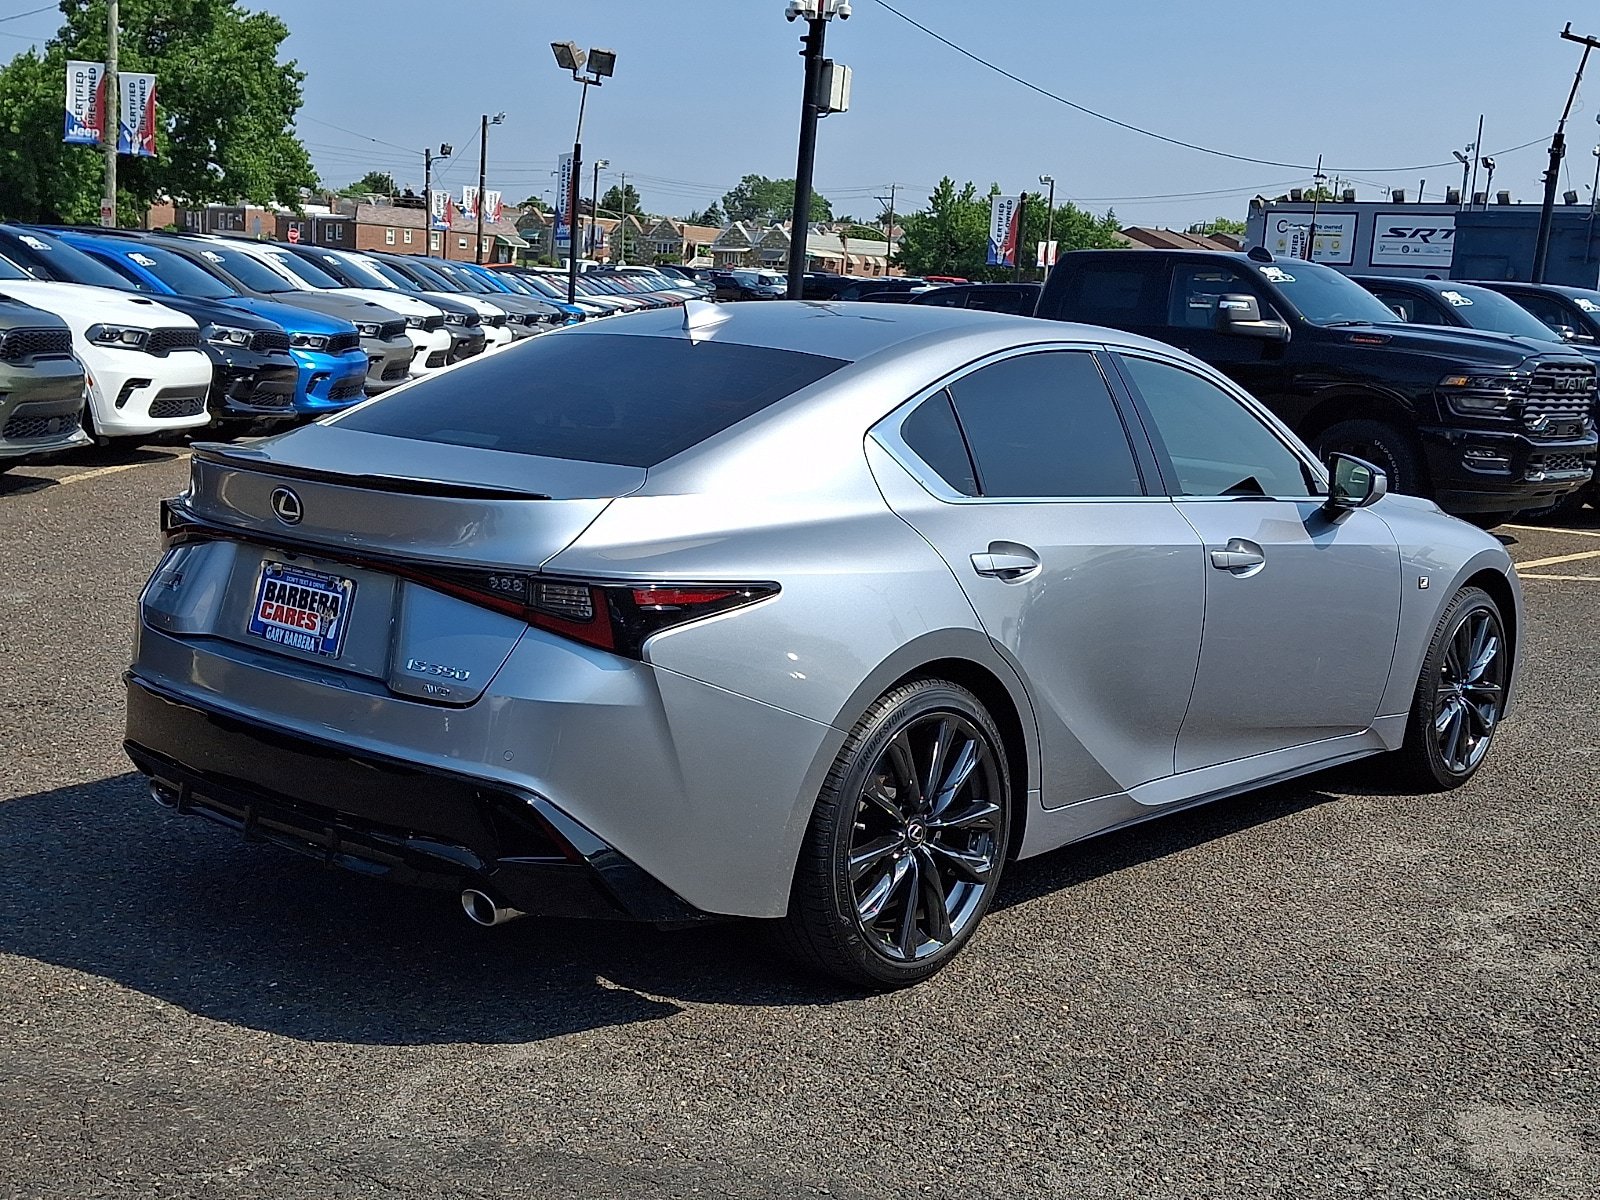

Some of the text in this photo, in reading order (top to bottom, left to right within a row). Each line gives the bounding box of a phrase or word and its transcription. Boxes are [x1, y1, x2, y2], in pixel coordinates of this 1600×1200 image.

[74, 71, 84, 122] CERTIFIED
[88, 67, 97, 127] PRE-OWNED
[128, 82, 136, 128] CERTIFIED
[68, 124, 100, 138] Jeep
[996, 203, 1005, 243] CERTIFIED
[1381, 227, 1456, 243] SRT
[260, 601, 320, 631] CARES
[264, 580, 341, 618] BARBERA
[266, 625, 315, 652] GARY BARBERA
[406, 658, 471, 681] IS 350
[857, 706, 908, 772] BRIDGESTONE
